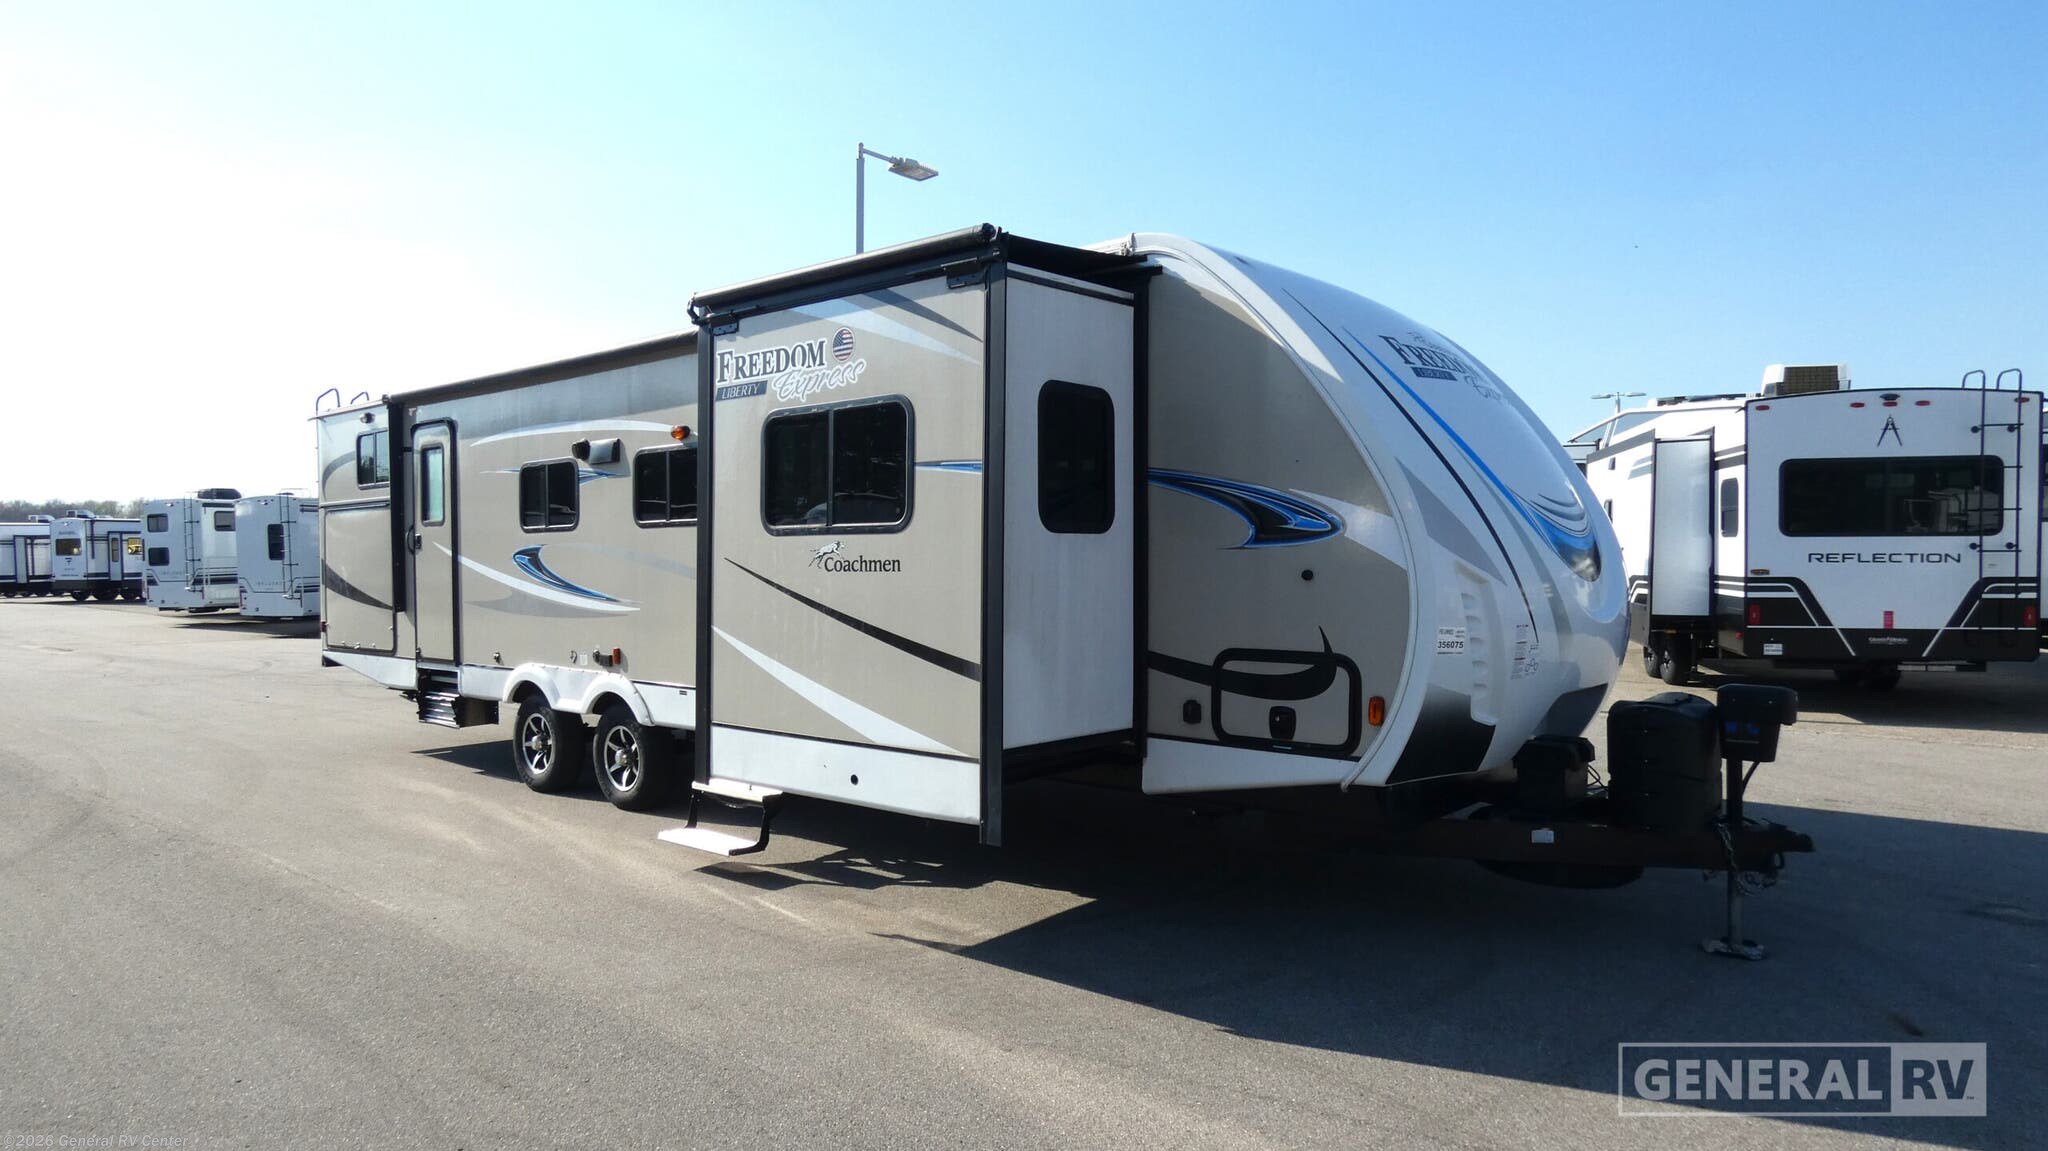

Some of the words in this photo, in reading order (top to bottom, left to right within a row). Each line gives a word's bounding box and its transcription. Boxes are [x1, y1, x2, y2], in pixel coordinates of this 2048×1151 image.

[717, 340, 826, 383] FREEDOM
[772, 360, 866, 402] Express
[721, 383, 761, 400] LIBERTY
[824, 555, 901, 572] Coachmen
[1808, 552, 1961, 563] REFLECTION
